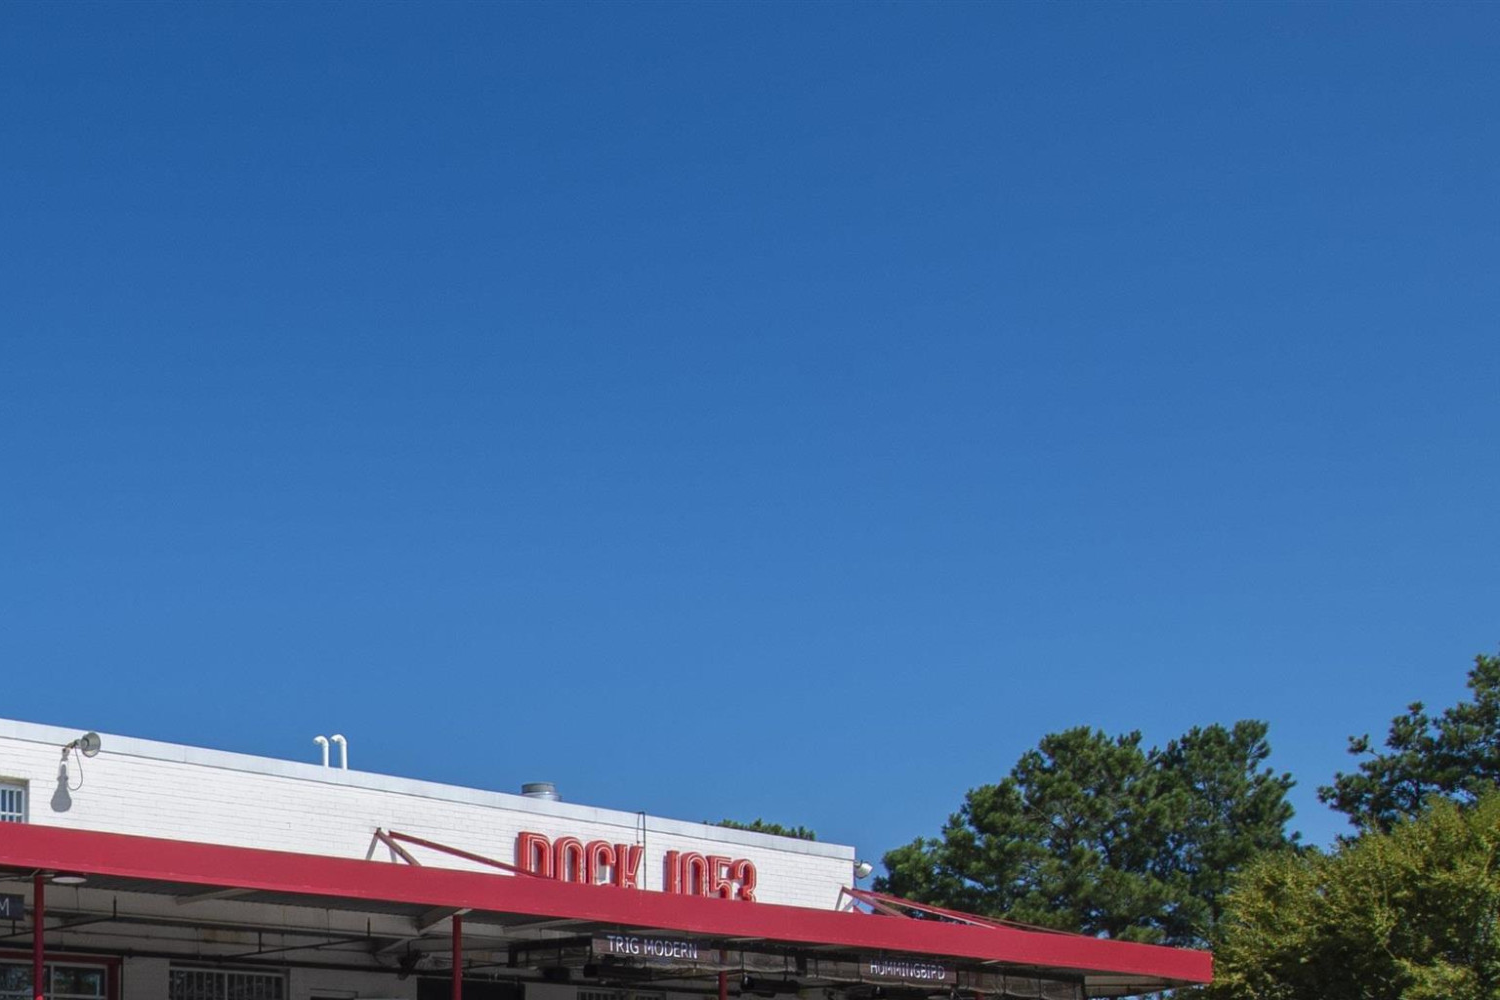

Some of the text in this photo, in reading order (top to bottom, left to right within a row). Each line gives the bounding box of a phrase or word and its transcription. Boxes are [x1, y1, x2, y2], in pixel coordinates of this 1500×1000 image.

[518, 831, 757, 902] DOCK 1053
[606, 935, 698, 960] TRIG MODERN
[870, 960, 946, 980] HUMMINGBIRD
